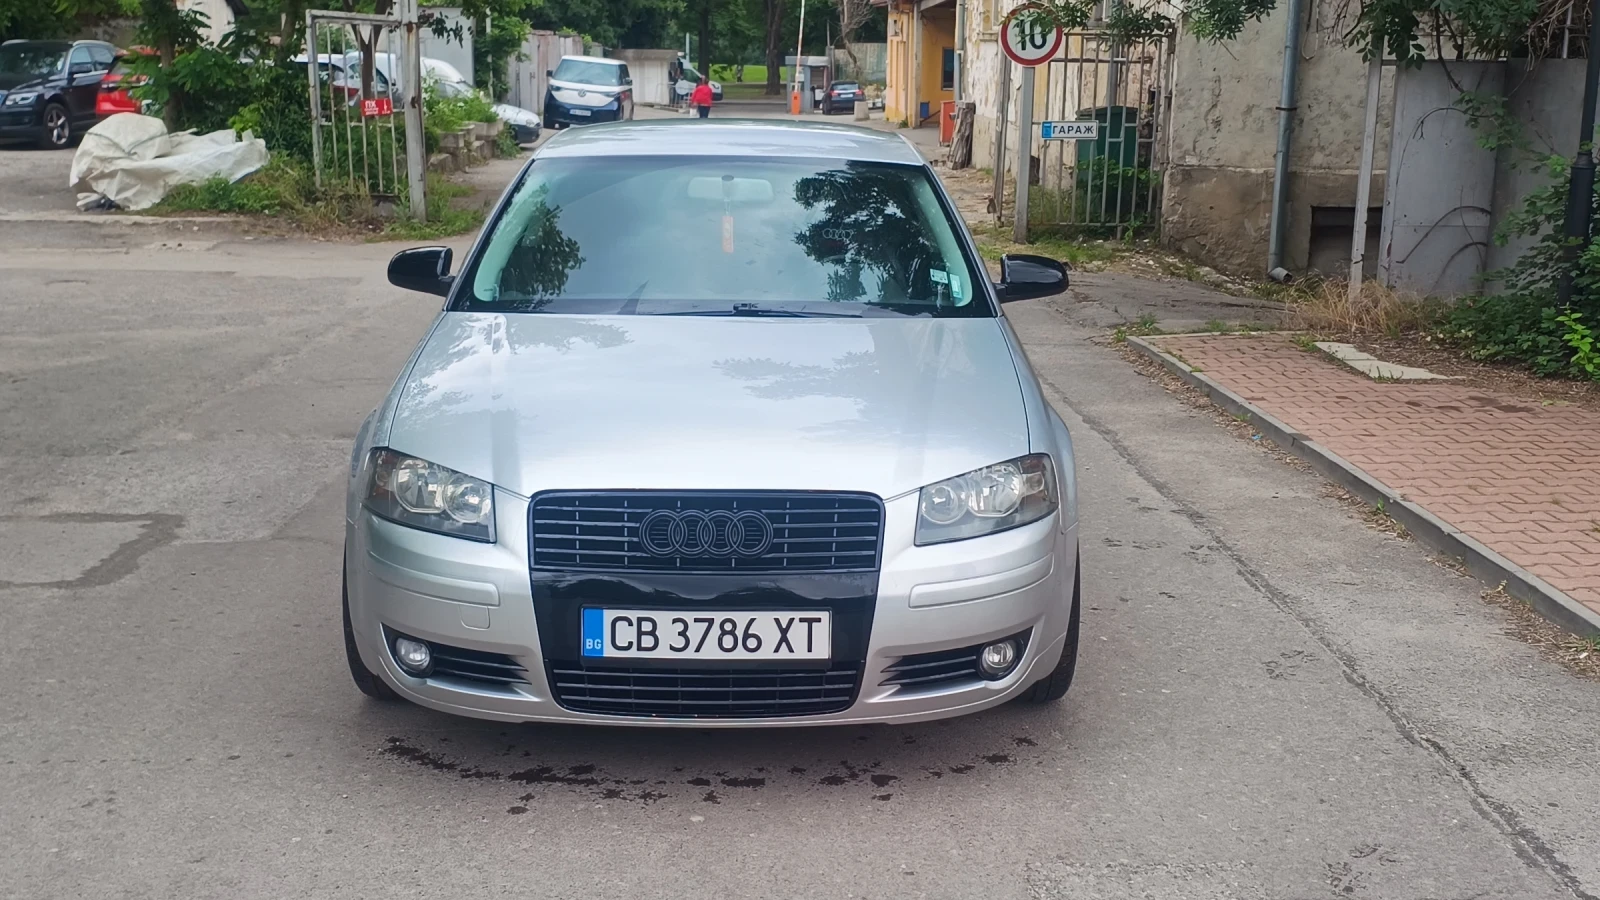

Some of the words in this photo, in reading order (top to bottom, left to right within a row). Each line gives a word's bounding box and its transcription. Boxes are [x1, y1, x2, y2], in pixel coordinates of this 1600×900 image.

[1052, 125, 1094, 135] ГАРАЖ
[610, 616, 660, 652] CB
[669, 617, 762, 653] 3786
[773, 617, 822, 653] XT
[586, 638, 602, 649] BG
